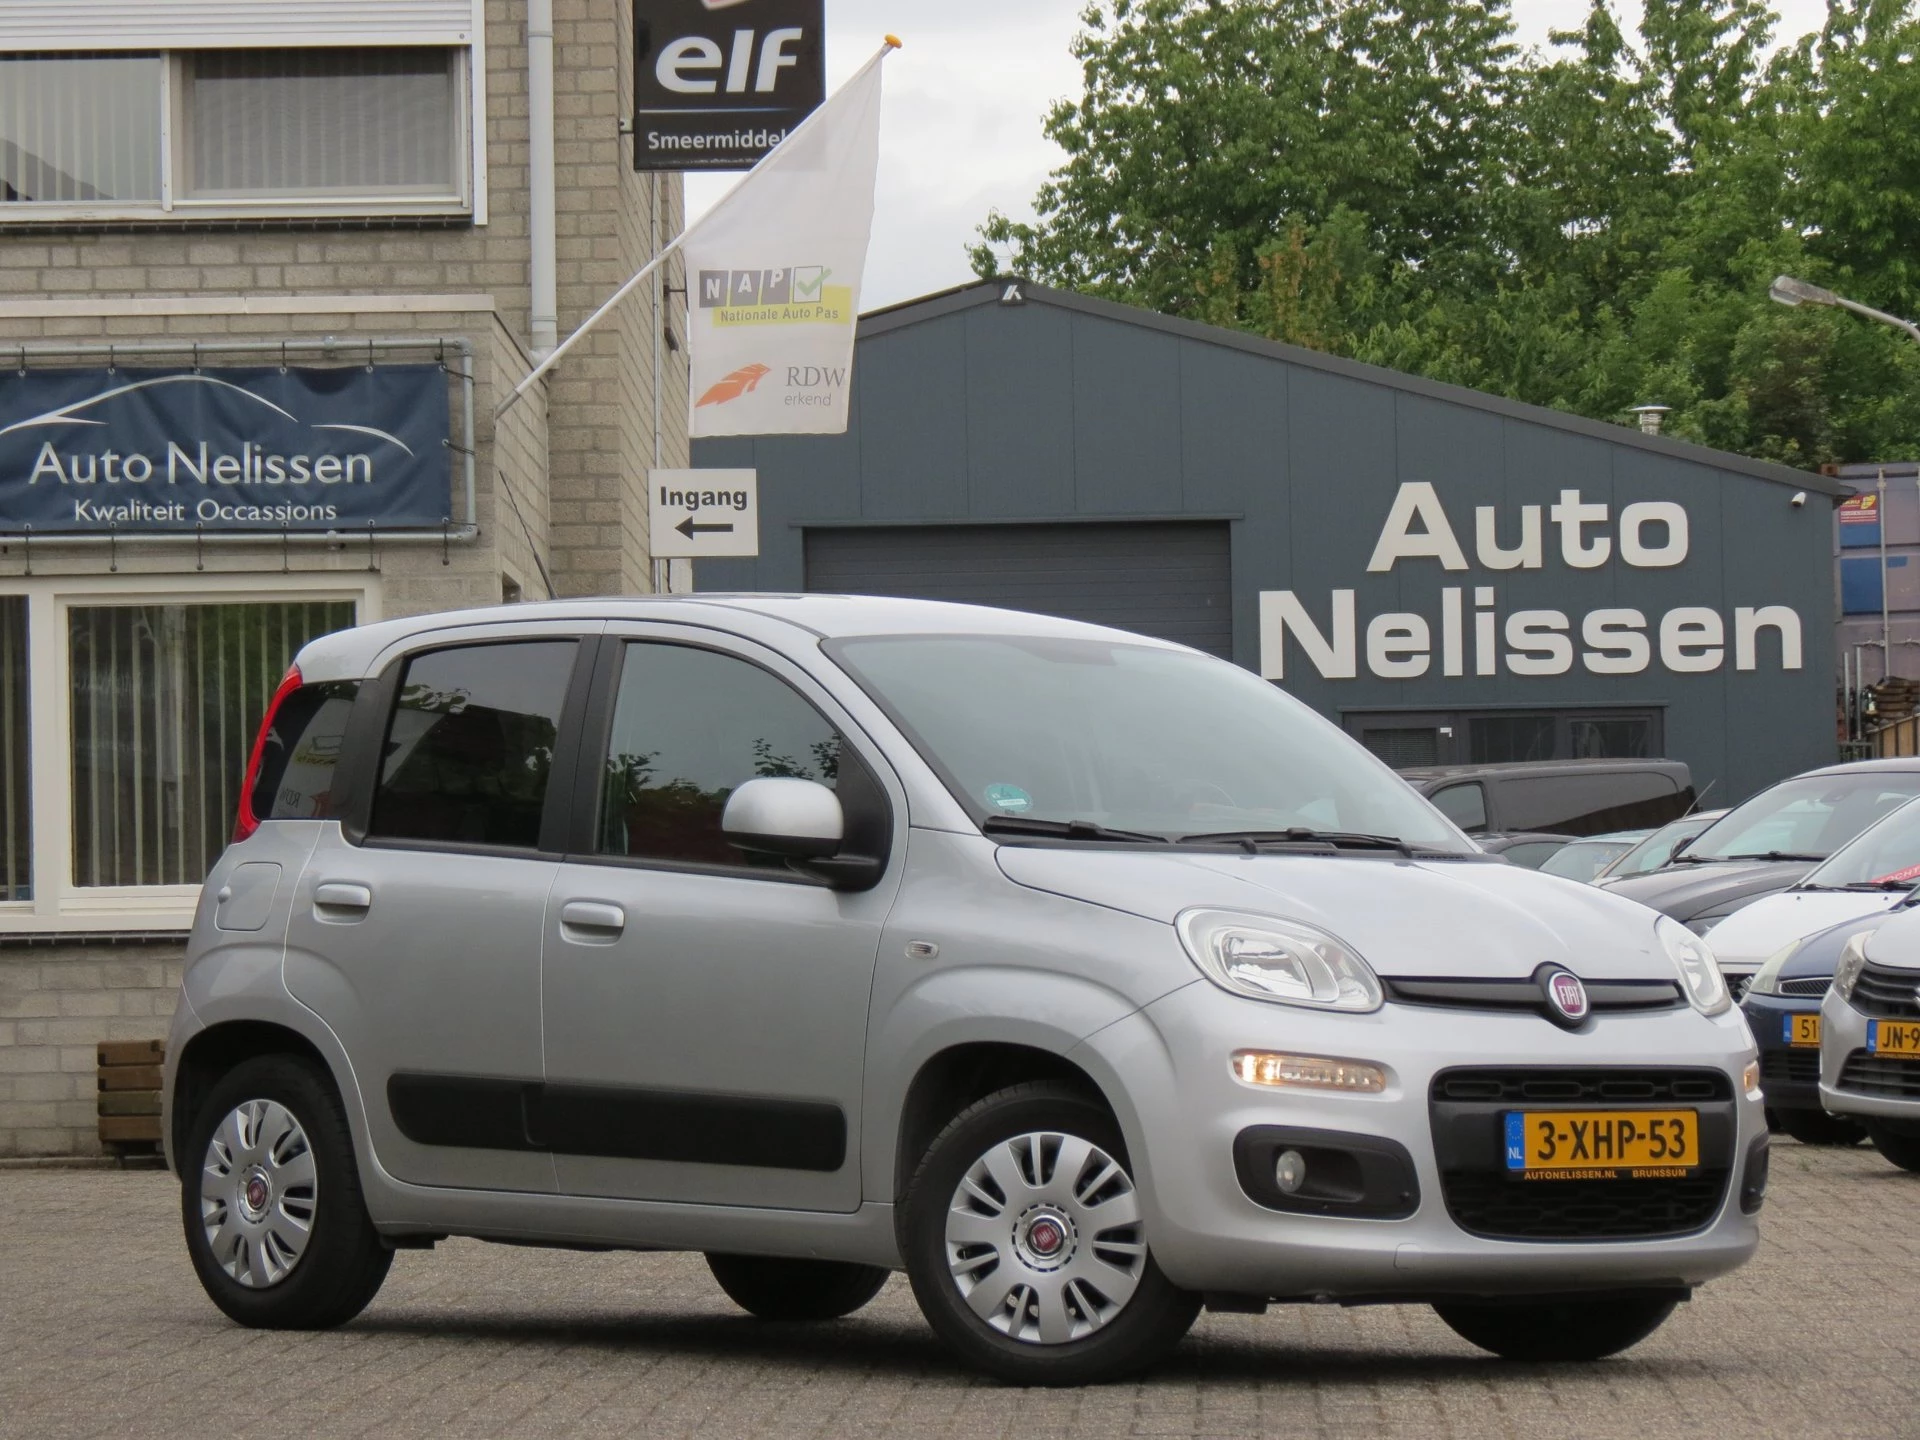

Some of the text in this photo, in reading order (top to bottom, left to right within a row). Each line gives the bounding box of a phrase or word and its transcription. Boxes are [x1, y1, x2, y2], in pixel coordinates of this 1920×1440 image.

[655, 27, 803, 93] elf
[720, 306, 839, 323] Nationale Auto Pas
[786, 366, 846, 388] RDW
[784, 392, 831, 406] erkend
[29, 440, 371, 485] Auto Nelissen
[660, 486, 748, 511] Ingang
[74, 499, 337, 522] Kwaliteit Occassions
[1366, 481, 1689, 572] Auto
[1259, 586, 1802, 681] Nelissen
[1557, 985, 1580, 1005] FIAT
[1538, 1119, 1686, 1160] 3-XHP-53
[1508, 1147, 1523, 1159] NL
[1524, 1168, 1687, 1180] AUTONELISSEN.NL BRUNSSUM
